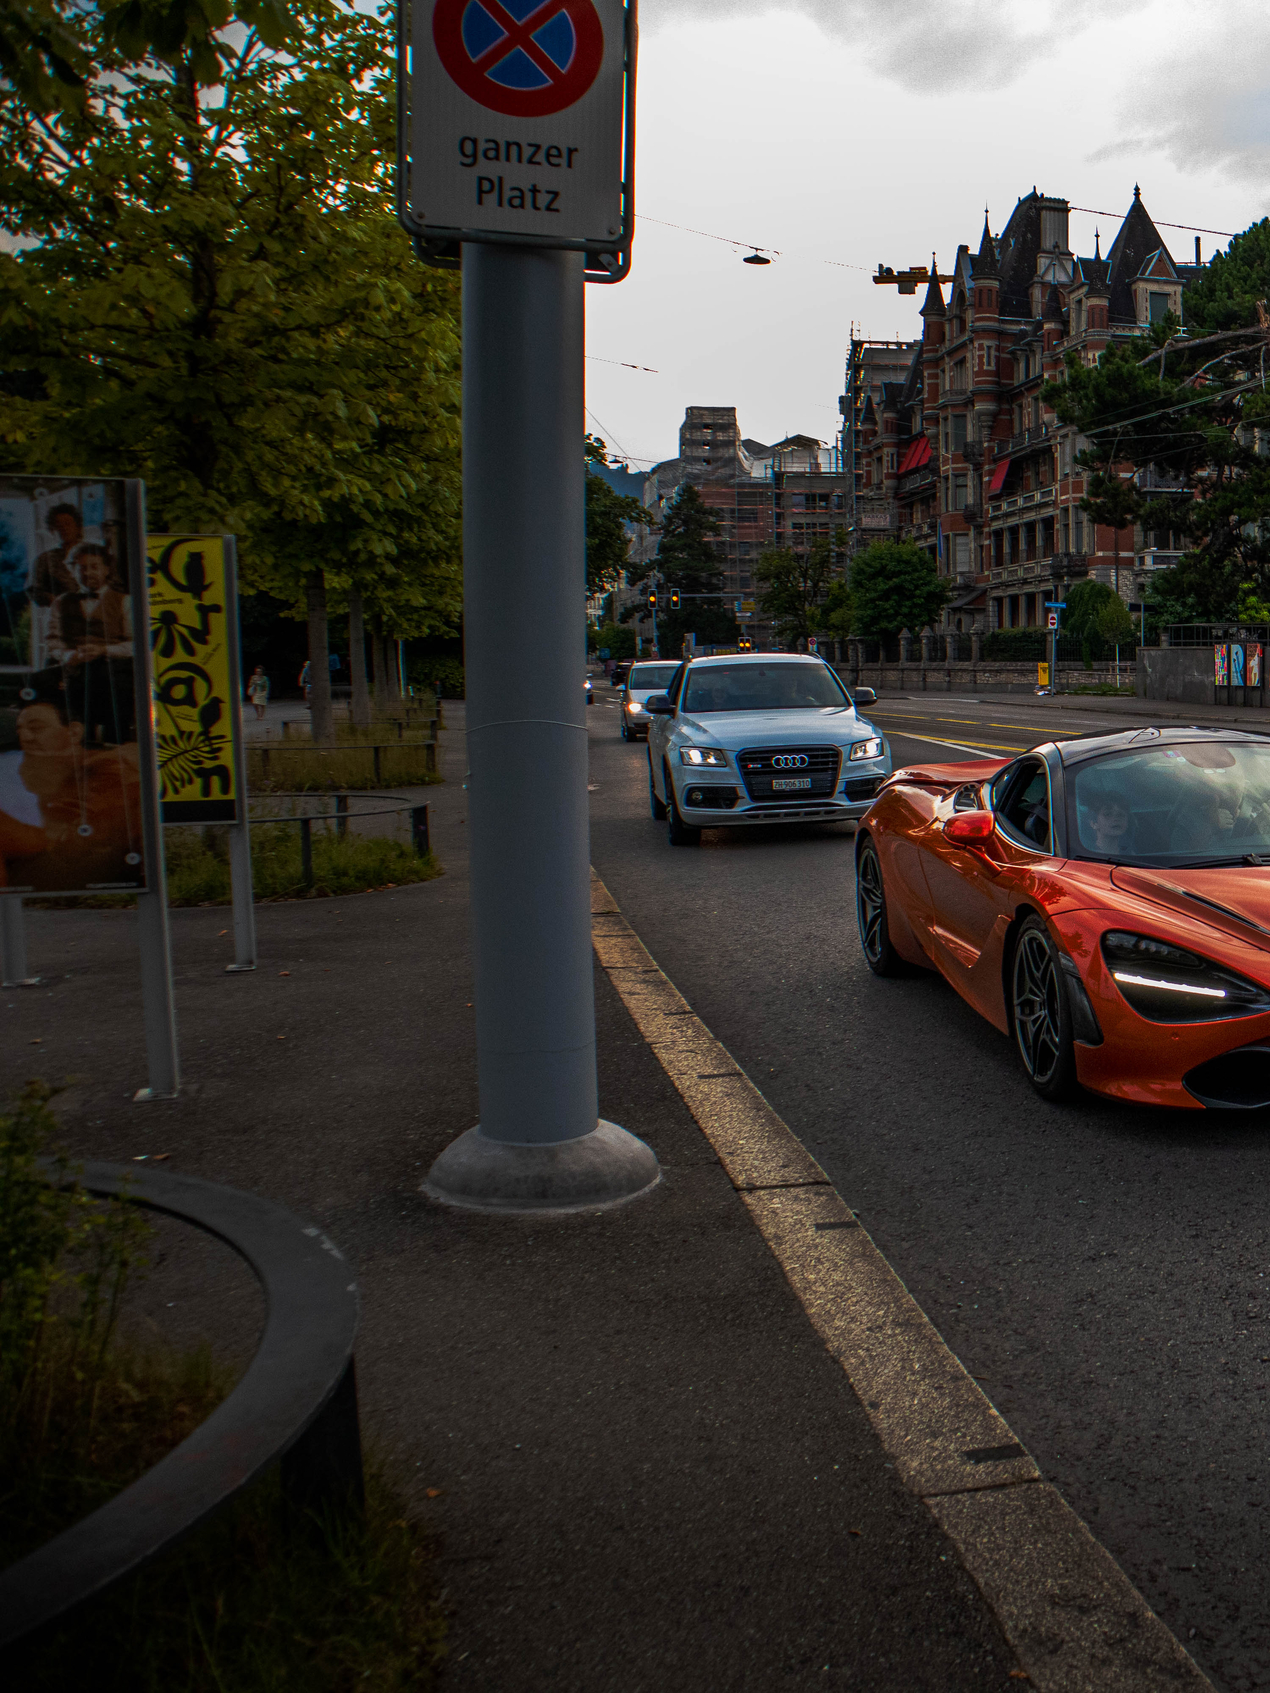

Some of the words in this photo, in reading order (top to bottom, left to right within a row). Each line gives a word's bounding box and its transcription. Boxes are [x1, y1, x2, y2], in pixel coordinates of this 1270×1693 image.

[458, 135, 579, 169] ganzer
[475, 175, 562, 213] Platz
[784, 780, 797, 788] 906
[797, 779, 810, 787] 310
